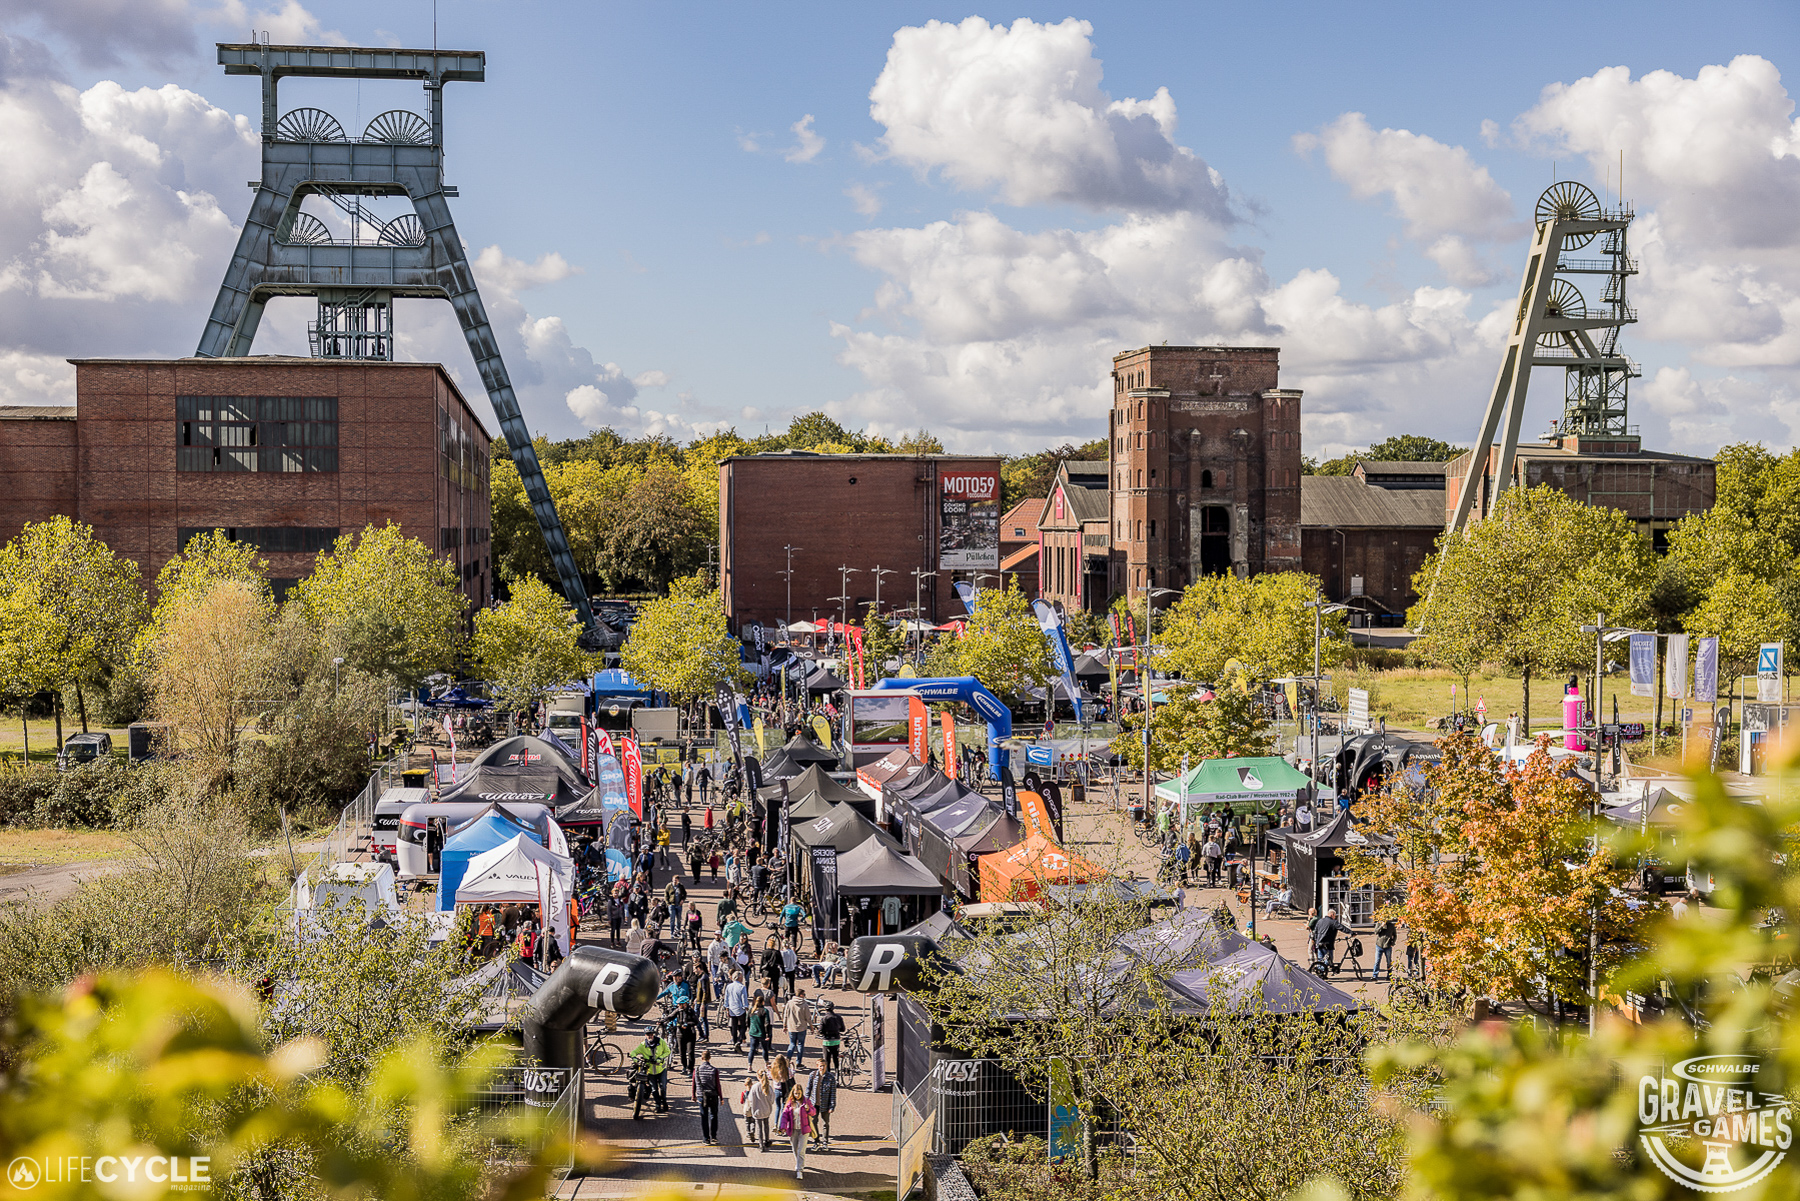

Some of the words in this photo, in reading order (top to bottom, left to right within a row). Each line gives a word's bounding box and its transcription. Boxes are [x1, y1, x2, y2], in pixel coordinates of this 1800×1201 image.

[944, 477, 995, 494] MOTO59
[587, 962, 632, 1012] R
[858, 943, 905, 991] R
